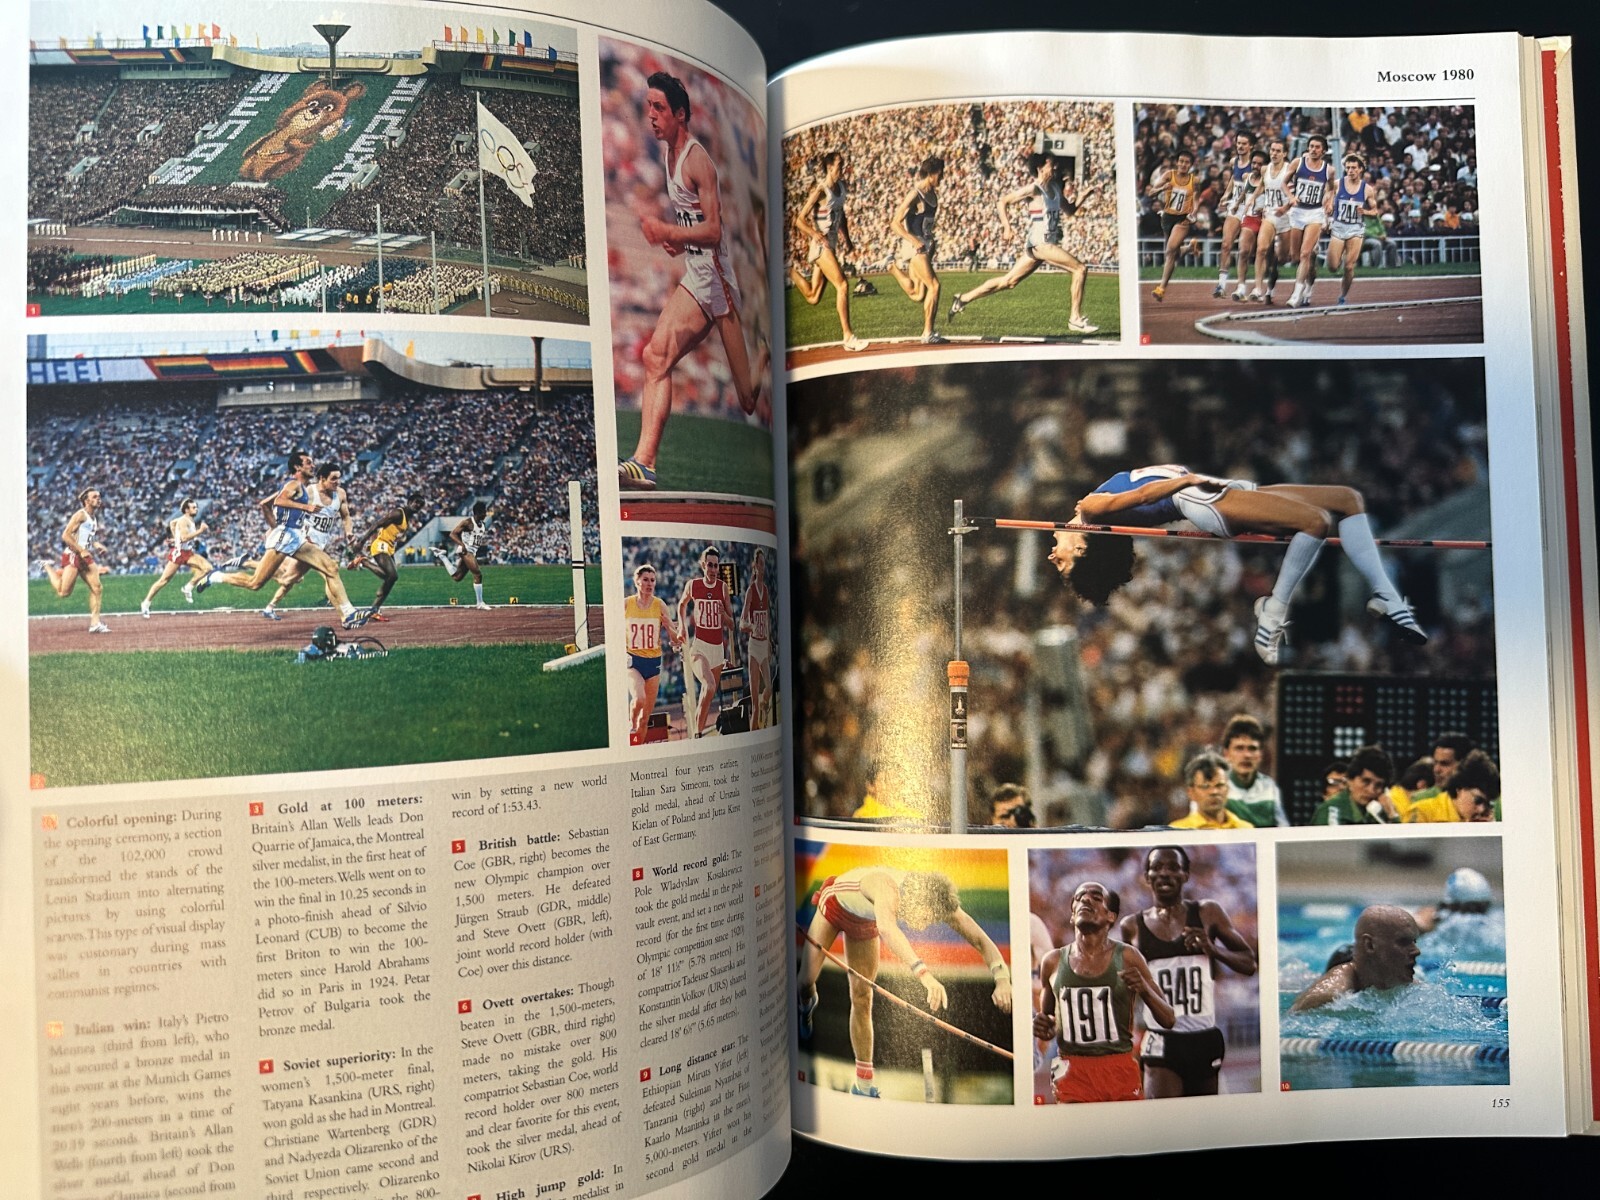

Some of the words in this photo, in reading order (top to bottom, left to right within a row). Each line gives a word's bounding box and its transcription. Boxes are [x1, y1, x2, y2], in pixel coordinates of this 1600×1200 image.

[1377, 71, 1436, 82] Moscow
[1442, 69, 1474, 80] 1980
[1170, 190, 1184, 212] 78
[1297, 182, 1320, 204] 296
[1340, 203, 1360, 224] 244
[700, 602, 718, 628] 288
[631, 624, 654, 649] 218
[630, 768, 667, 781] Montreal
[675, 766, 690, 775] four
[697, 764, 714, 775] years
[630, 786, 655, 798] Italian
[660, 784, 676, 794] Sara
[713, 775, 727, 785] took
[730, 774, 739, 782] the
[277, 801, 308, 814] Gold
[320, 802, 331, 811] at
[345, 797, 364, 809] 100
[377, 796, 422, 806] meters:
[66, 814, 117, 828] Colorful
[123, 814, 176, 826] opening:
[182, 809, 221, 820] During
[251, 821, 294, 834] Britain’s
[300, 819, 327, 830] Allan
[332, 816, 361, 827] Wells
[367, 813, 393, 825] leads
[399, 812, 423, 822] Don
[252, 840, 295, 854] Quarrie
[298, 838, 312, 850] of
[310, 836, 354, 851] Jamaica,
[356, 833, 373, 844] the
[376, 829, 424, 842] Montreal
[478, 836, 516, 850] British
[526, 832, 559, 844] battle:
[568, 826, 608, 839] Sebastian
[252, 860, 280, 871] silver
[283, 855, 329, 868] medalist,
[331, 855, 342, 865] in
[345, 852, 362, 863] the
[366, 851, 385, 861] first
[388, 849, 410, 859] heat
[414, 846, 427, 857] of
[453, 860, 475, 871] Coe
[481, 855, 515, 869] (GBR,
[519, 850, 546, 865] right)
[551, 847, 591, 859] becomes
[595, 843, 609, 852] the
[651, 863, 677, 876] World
[683, 857, 707, 870] record
[712, 852, 728, 866] gold:
[731, 850, 742, 859] The
[252, 878, 270, 889] the
[274, 874, 337, 887] 100-meters.
[338, 870, 365, 882] Wells
[368, 870, 394, 879] went
[414, 867, 425, 875] to
[454, 879, 476, 888] new
[484, 870, 528, 886] Olympic
[536, 864, 583, 878] champion
[591, 862, 610, 870] over
[254, 898, 274, 907] win
[278, 894, 295, 905] the
[298, 891, 321, 904] final
[324, 892, 335, 901] in
[340, 887, 368, 900] 10.25
[372, 884, 412, 897] seconds
[415, 885, 426, 893] in
[456, 893, 484, 906] 1,500
[497, 890, 534, 901] meters.
[545, 883, 560, 894] He
[572, 876, 611, 890] defeated
[254, 918, 260, 926] a
[267, 909, 333, 927] photo-finish
[341, 905, 371, 918] ahead
[378, 903, 391, 914] of
[397, 901, 427, 913] Silvio
[255, 930, 299, 944] Leonard
[305, 926, 341, 941] (CUB)
[347, 927, 358, 936] to
[364, 923, 405, 934] become
[410, 919, 427, 929] the
[256, 951, 275, 962] first
[285, 948, 320, 960] Briton
[329, 948, 340, 956] to
[348, 945, 369, 953] win
[378, 940, 395, 951] the
[404, 936, 428, 948] 100-
[256, 970, 292, 981] meters
[300, 967, 326, 977] since
[334, 960, 371, 973] Harold
[377, 956, 429, 969] Abrahams
[482, 997, 513, 1009] Ovett
[520, 988, 573, 1003] overtakes:
[577, 979, 614, 993] Though
[460, 1019, 494, 1031] beaten
[504, 1014, 514, 1024] in
[524, 1010, 540, 1021] the
[550, 997, 615, 1016] 1,500-meters,
[1062, 988, 1113, 1042] 191
[283, 1058, 319, 1070] Soviet
[326, 1051, 395, 1067] superiority:
[401, 1047, 412, 1057] In
[416, 1045, 433, 1055] the
[260, 1077, 310, 1092] women’s
[325, 1069, 393, 1085] 1,500-meter
[407, 1063, 434, 1074] final,
[262, 1099, 303, 1110] Tatyana
[308, 1090, 362, 1105] Kasankina
[367, 1084, 402, 1100] (URS,
[406, 1080, 434, 1094] right)
[1492, 1099, 1510, 1108] 155
